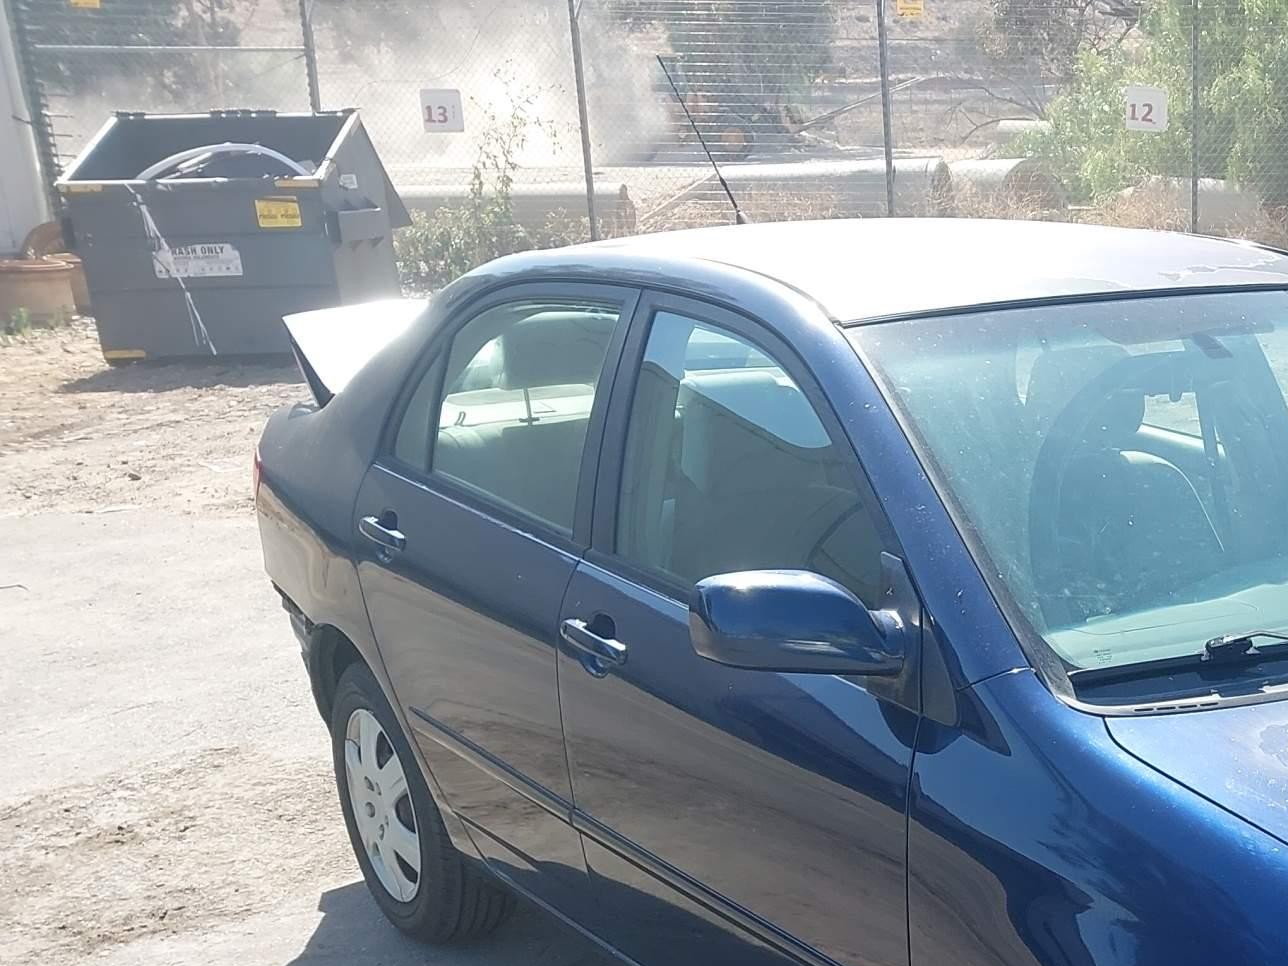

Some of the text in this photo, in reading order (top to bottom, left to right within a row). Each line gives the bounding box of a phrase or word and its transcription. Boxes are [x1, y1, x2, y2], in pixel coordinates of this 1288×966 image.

[424, 105, 448, 123] 13
[1129, 103, 1153, 122] 12
[200, 246, 224, 255] ONLY
